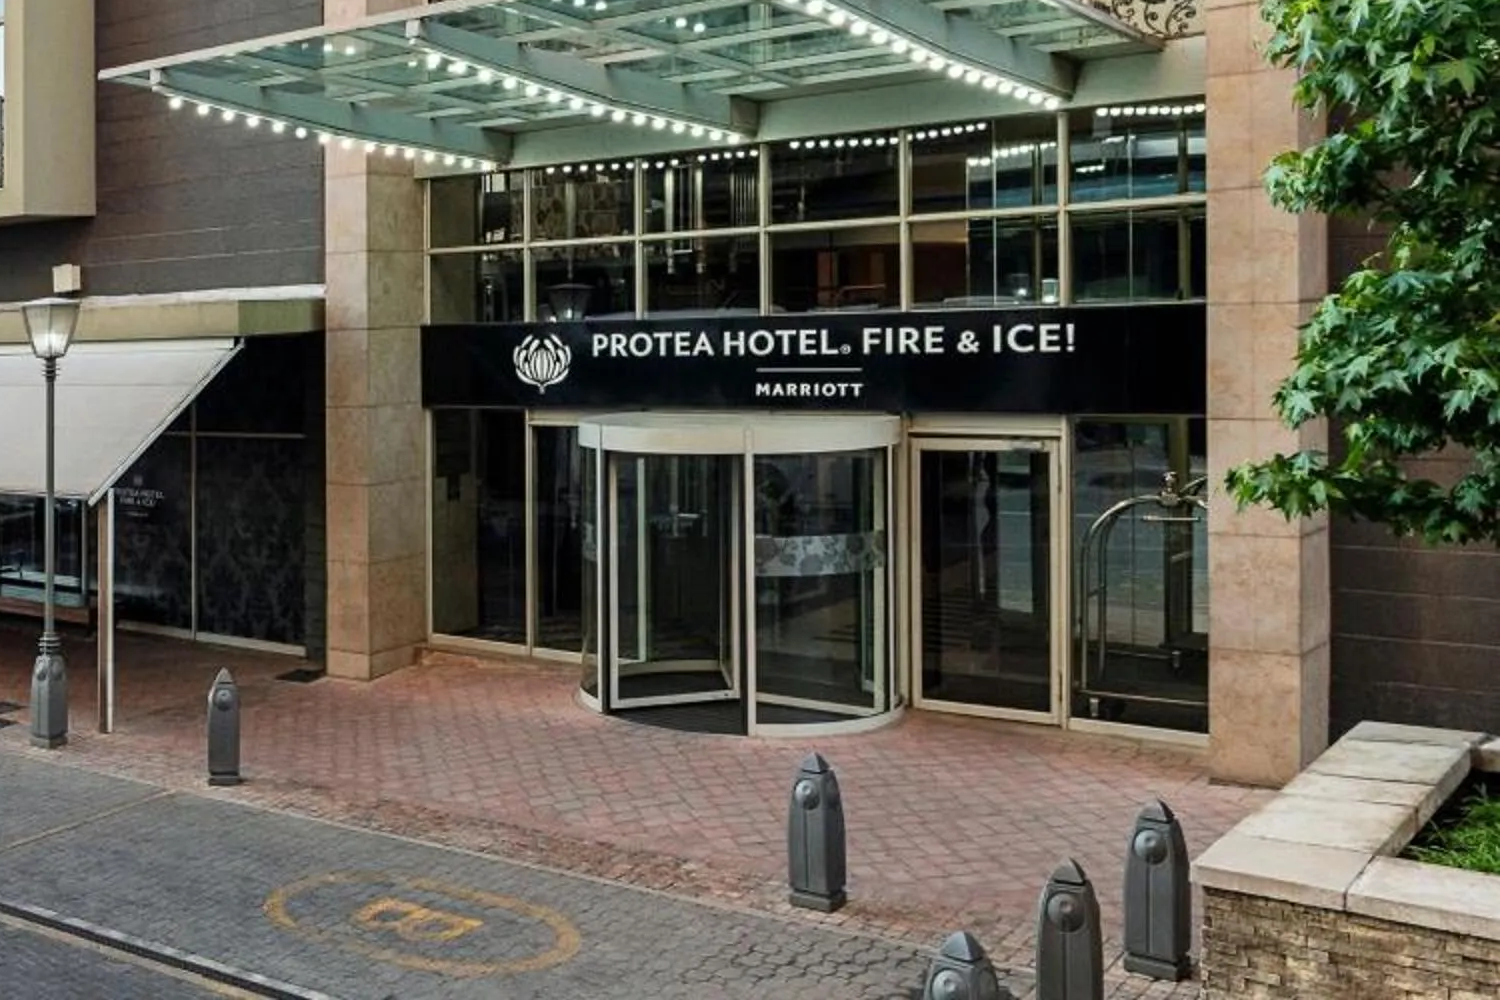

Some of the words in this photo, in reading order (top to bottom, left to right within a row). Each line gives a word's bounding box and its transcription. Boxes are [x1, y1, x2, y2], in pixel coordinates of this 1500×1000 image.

[593, 331, 714, 357] PROTEA
[863, 326, 944, 354] FIRE
[957, 331, 979, 353] &
[994, 324, 1074, 352] ICE!
[756, 383, 863, 396] MARRIOTT
